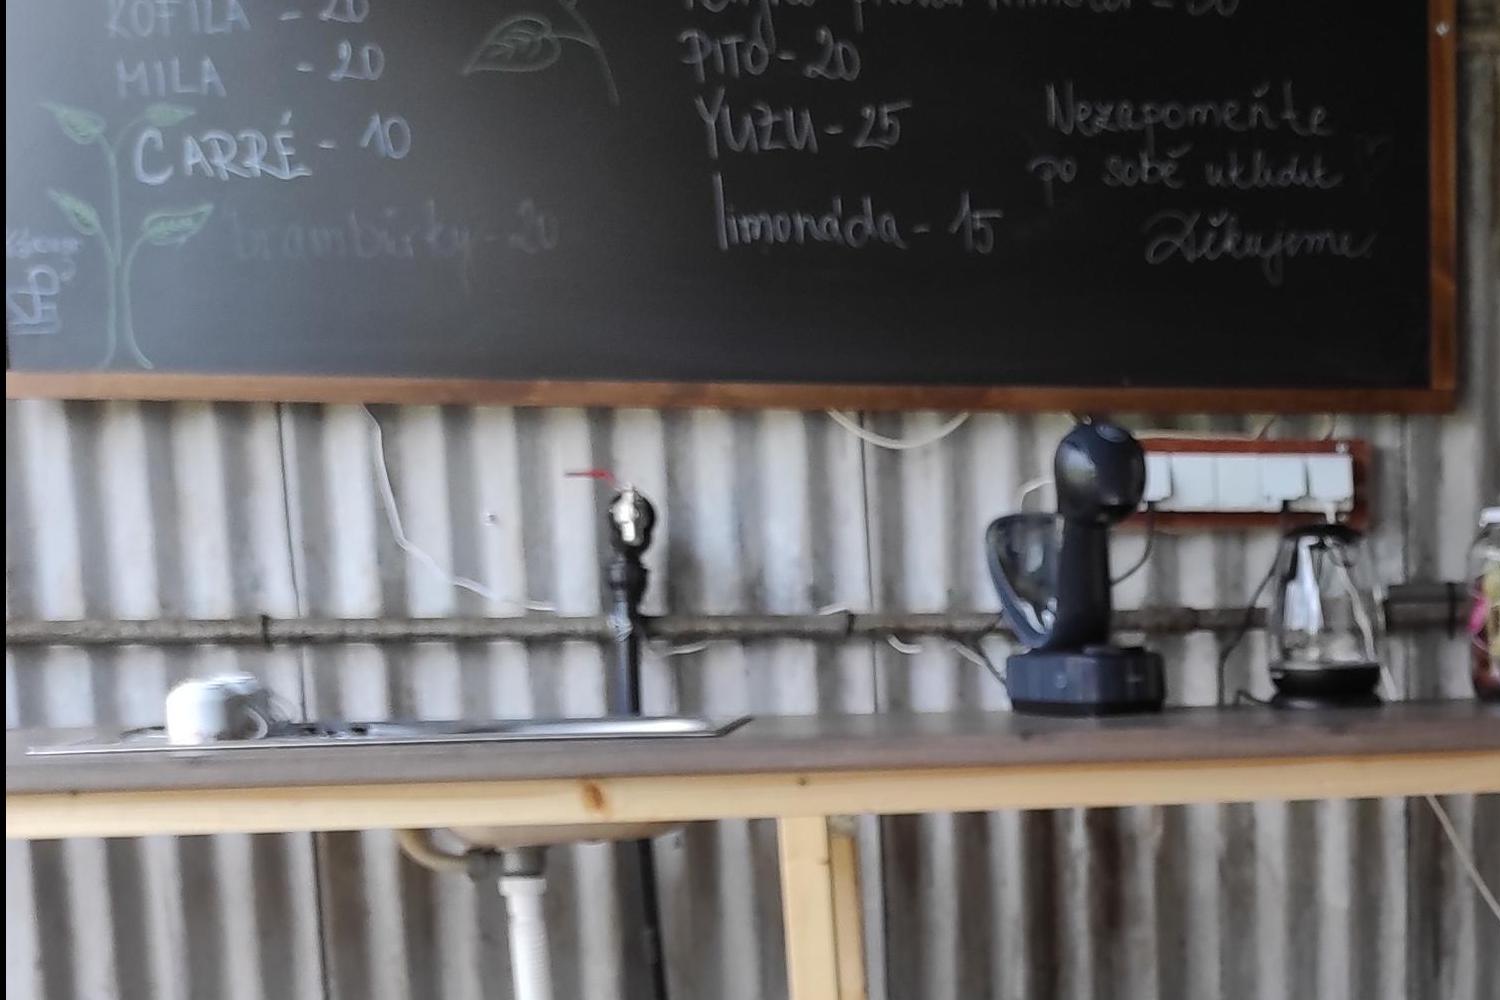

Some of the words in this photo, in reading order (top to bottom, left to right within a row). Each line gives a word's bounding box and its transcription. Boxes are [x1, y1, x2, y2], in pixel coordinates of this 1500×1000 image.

[115, 56, 228, 97] MILA
[133, 109, 313, 186] CARRÉ
[694, 86, 818, 160] YUZU
